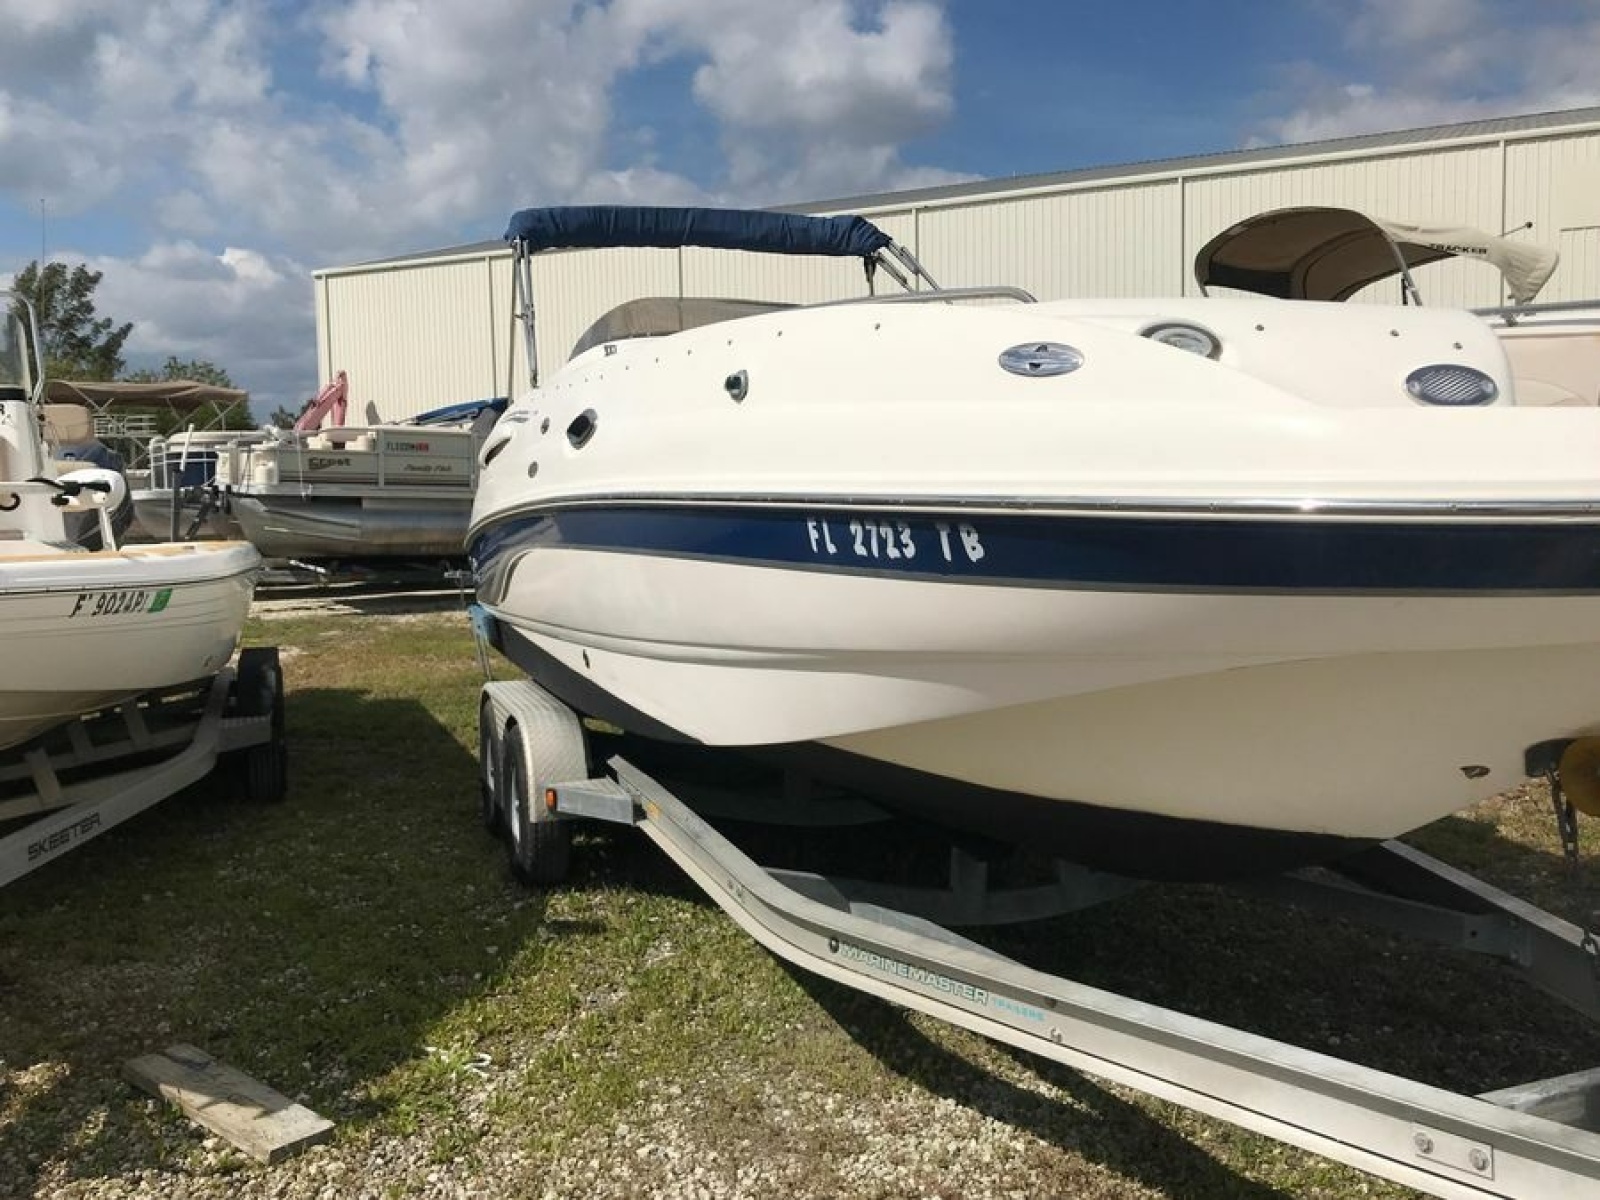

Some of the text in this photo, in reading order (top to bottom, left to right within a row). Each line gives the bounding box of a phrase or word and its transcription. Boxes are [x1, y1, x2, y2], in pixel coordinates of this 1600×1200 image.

[806, 516, 838, 555] FL
[849, 518, 916, 559] 2723
[27, 811, 101, 862] SKEETER
[839, 942, 990, 1005] MARINEMASTER
